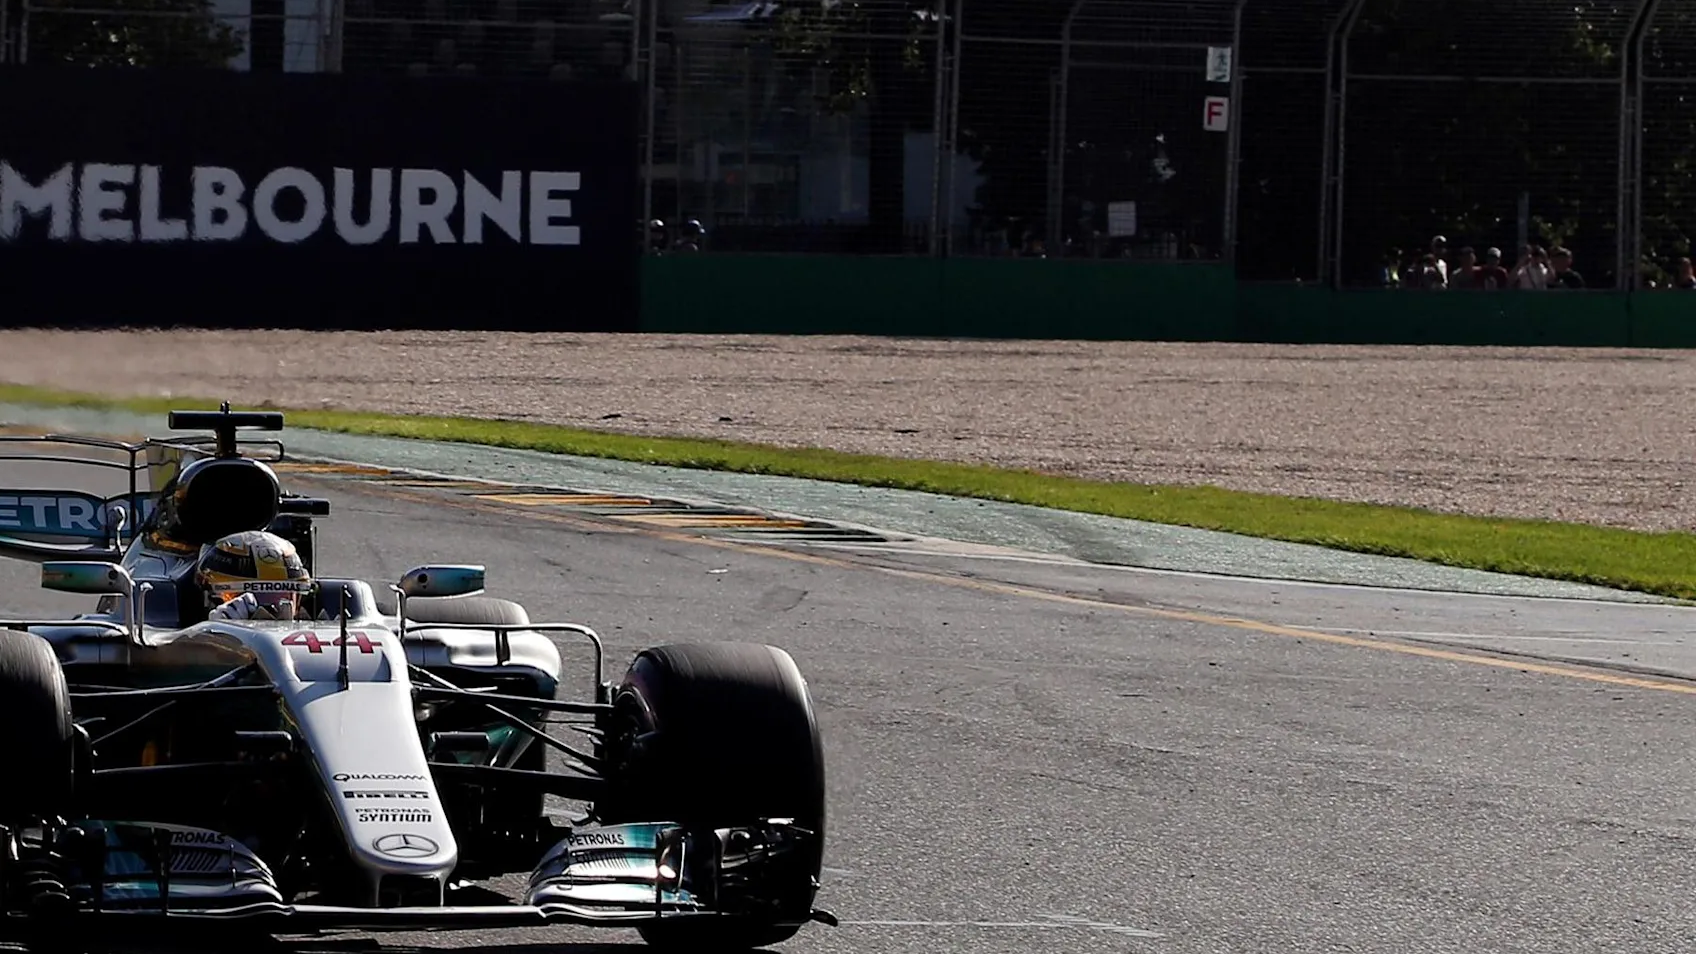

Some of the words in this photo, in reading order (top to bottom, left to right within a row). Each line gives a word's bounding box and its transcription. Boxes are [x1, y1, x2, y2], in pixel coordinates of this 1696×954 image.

[1207, 101, 1224, 126] F
[244, 582, 302, 592] PETRONAS
[281, 631, 383, 653] 44
[359, 813, 432, 823] SYNTIUM
[567, 832, 625, 846] PETRONAS
